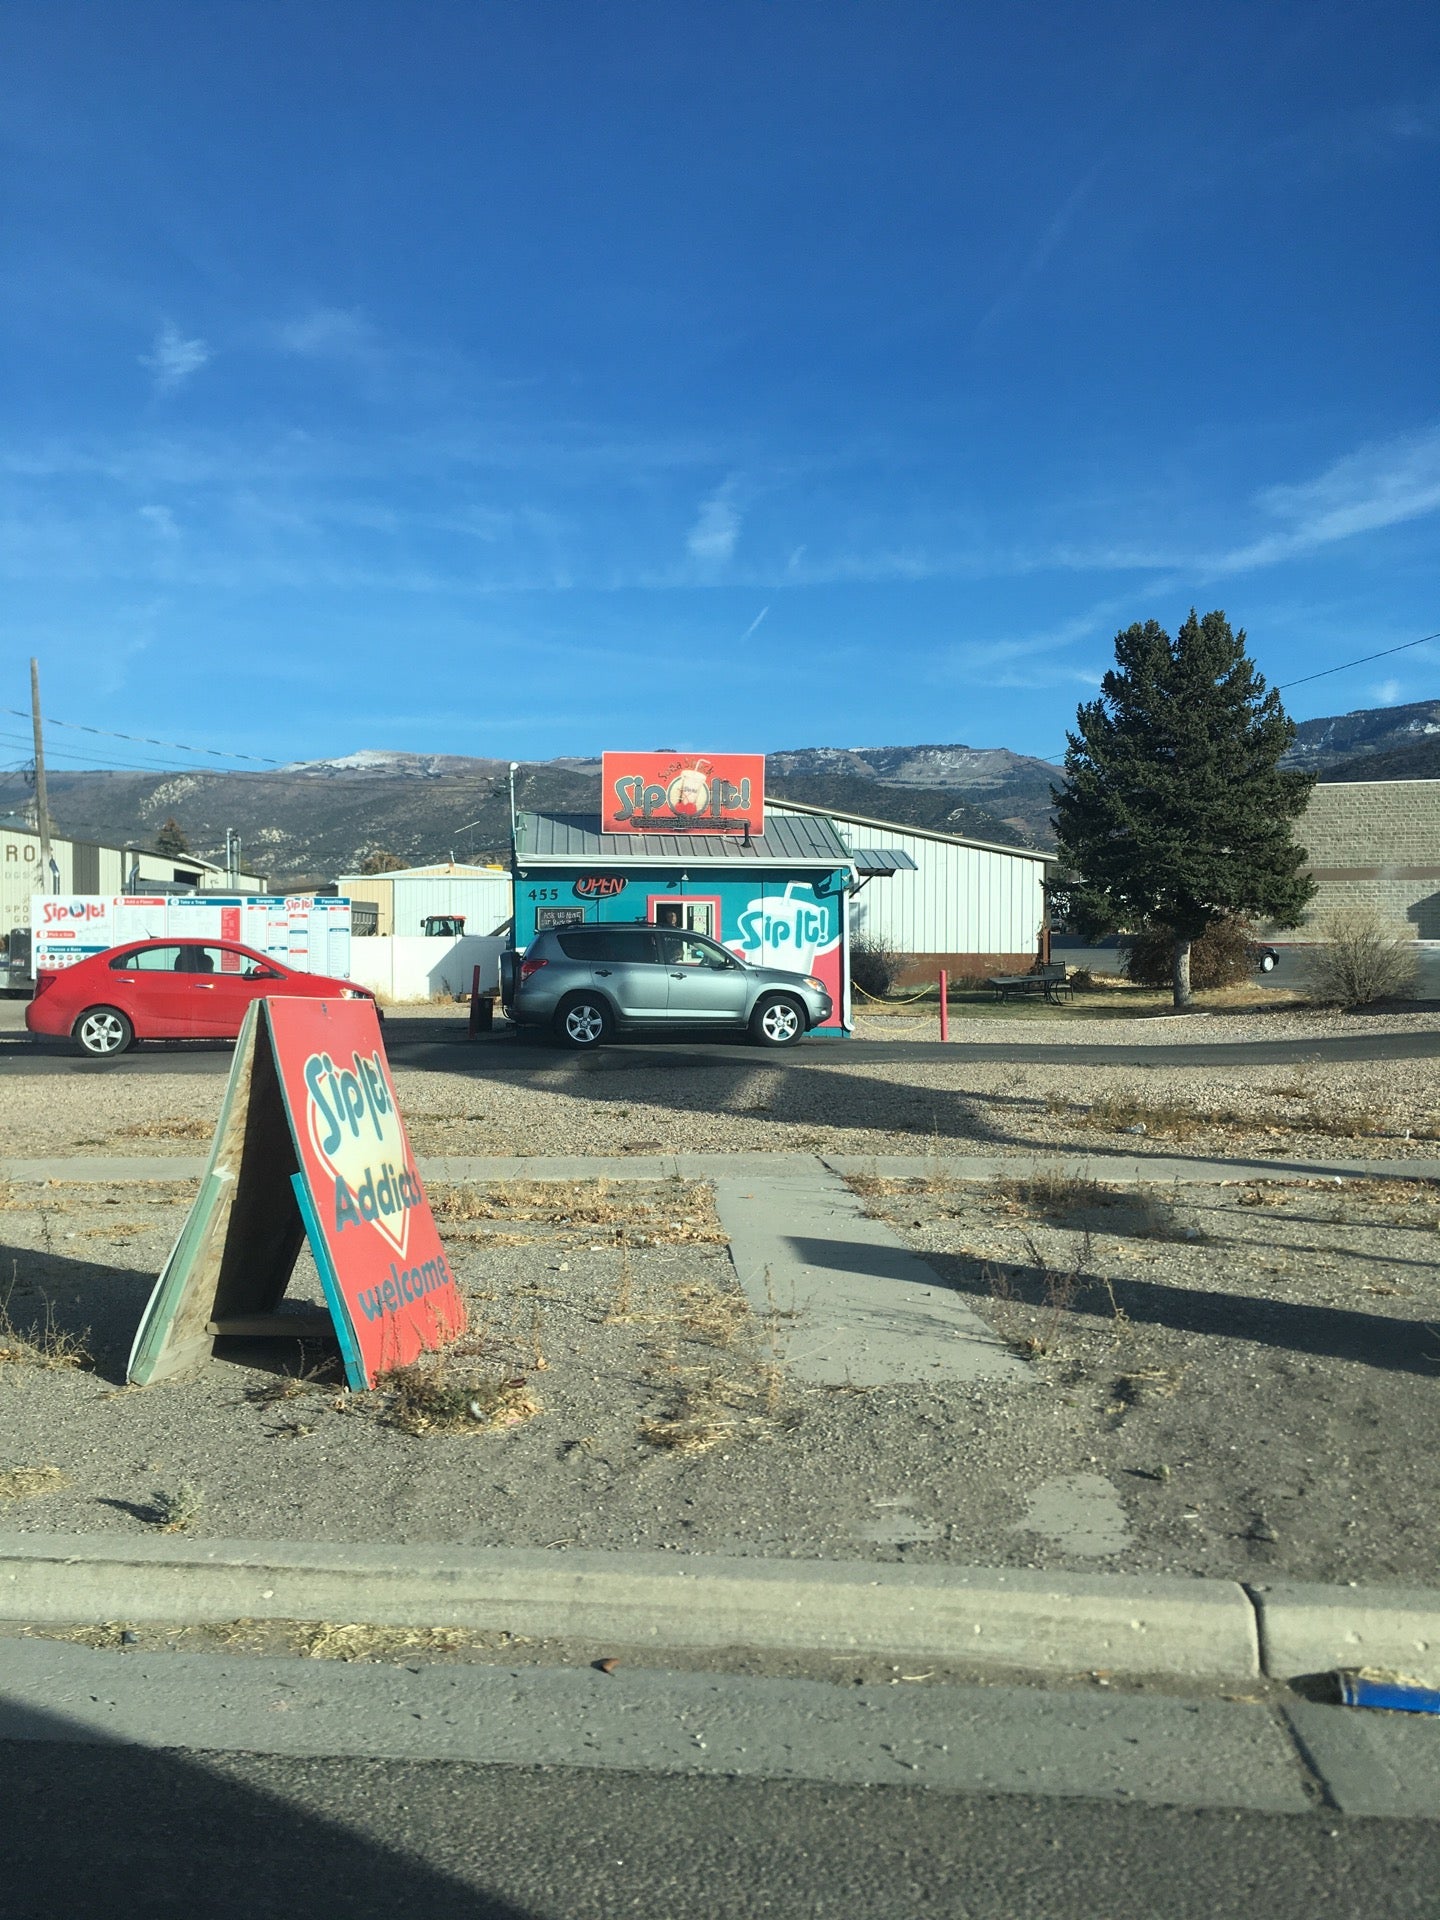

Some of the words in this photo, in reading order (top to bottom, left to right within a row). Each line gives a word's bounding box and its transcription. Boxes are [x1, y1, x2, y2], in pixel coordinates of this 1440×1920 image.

[613, 776, 667, 821] Sip
[711, 777, 751, 817] It!
[528, 888, 558, 901] 455
[576, 876, 624, 893] OPEN
[43, 902, 68, 923] Sip
[85, 902, 105, 921] It!
[285, 899, 300, 911] Sip
[301, 899, 313, 909] It!
[742, 911, 790, 949] Sip
[795, 909, 826, 948] It!
[304, 1053, 364, 1156] Sip
[353, 1052, 394, 1141] It!
[335, 1162, 422, 1233] Addicts
[357, 1255, 449, 1322] welcome
